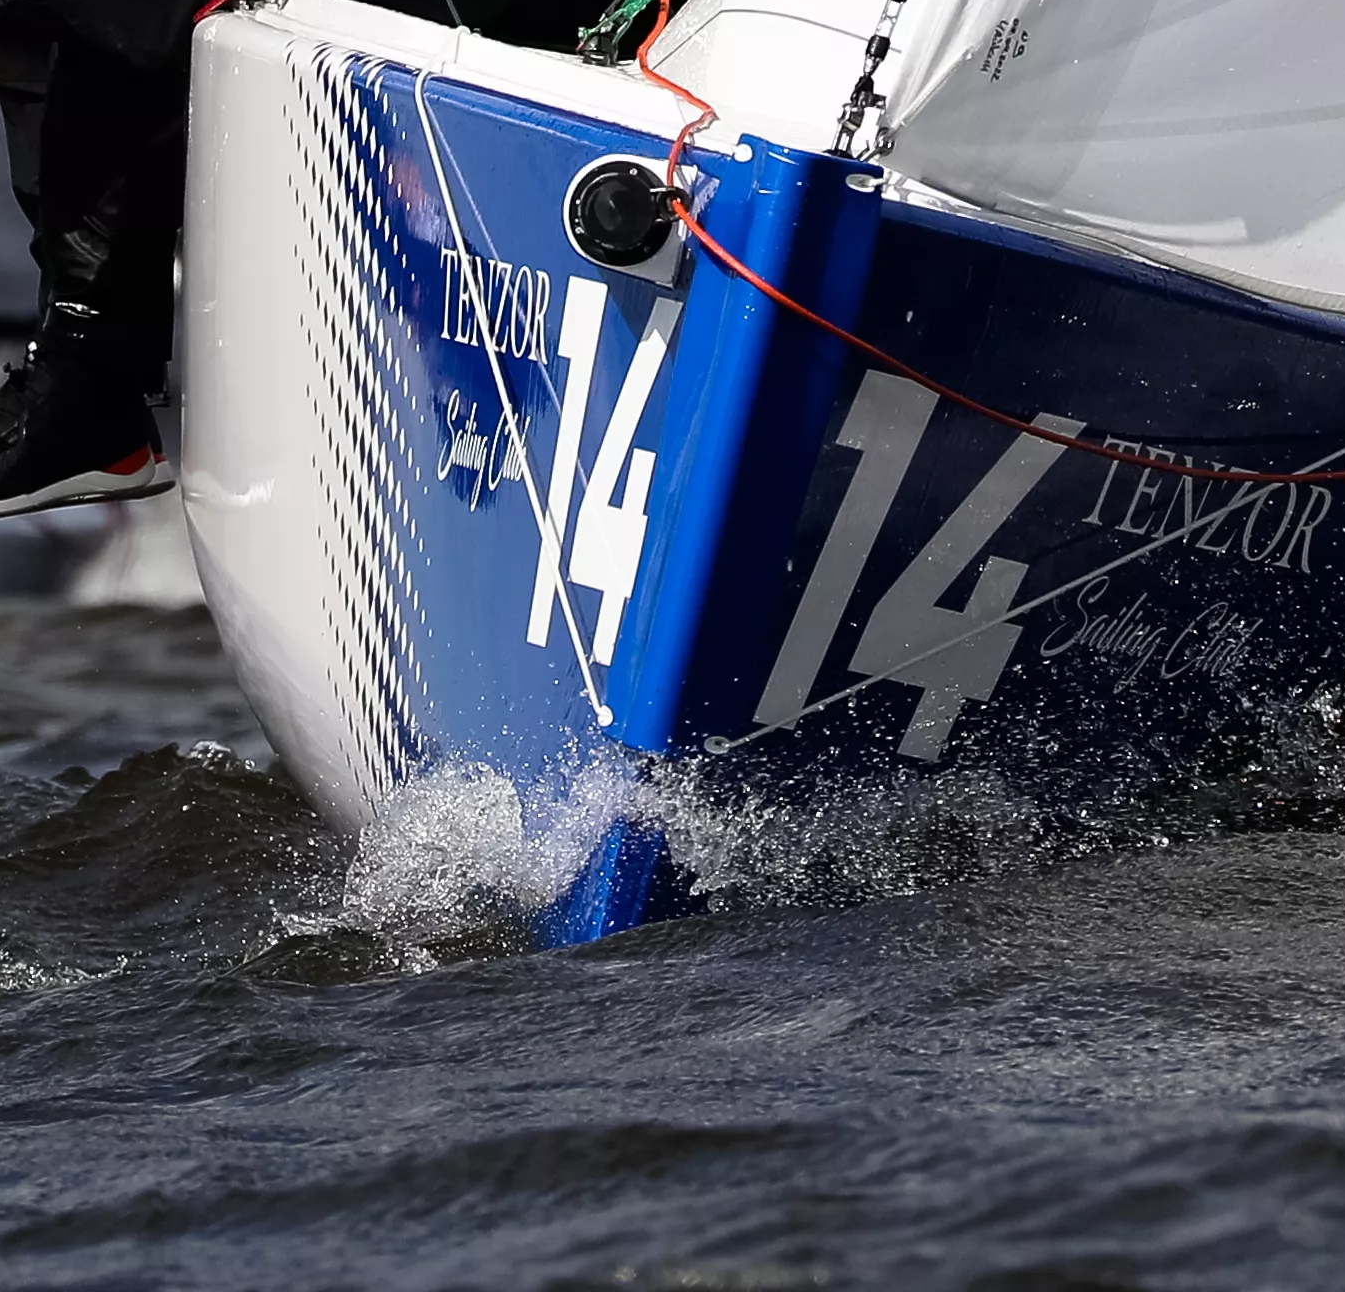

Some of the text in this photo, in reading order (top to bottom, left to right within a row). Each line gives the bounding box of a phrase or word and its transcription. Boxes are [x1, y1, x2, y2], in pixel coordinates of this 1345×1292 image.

[440, 244, 551, 365] TENZOR
[437, 389, 488, 512] Sailing
[526, 275, 683, 667] 14
[1081, 434, 1332, 573] TENZOR
[753, 369, 1087, 762] 14
[1040, 575, 1167, 695] Sailing
